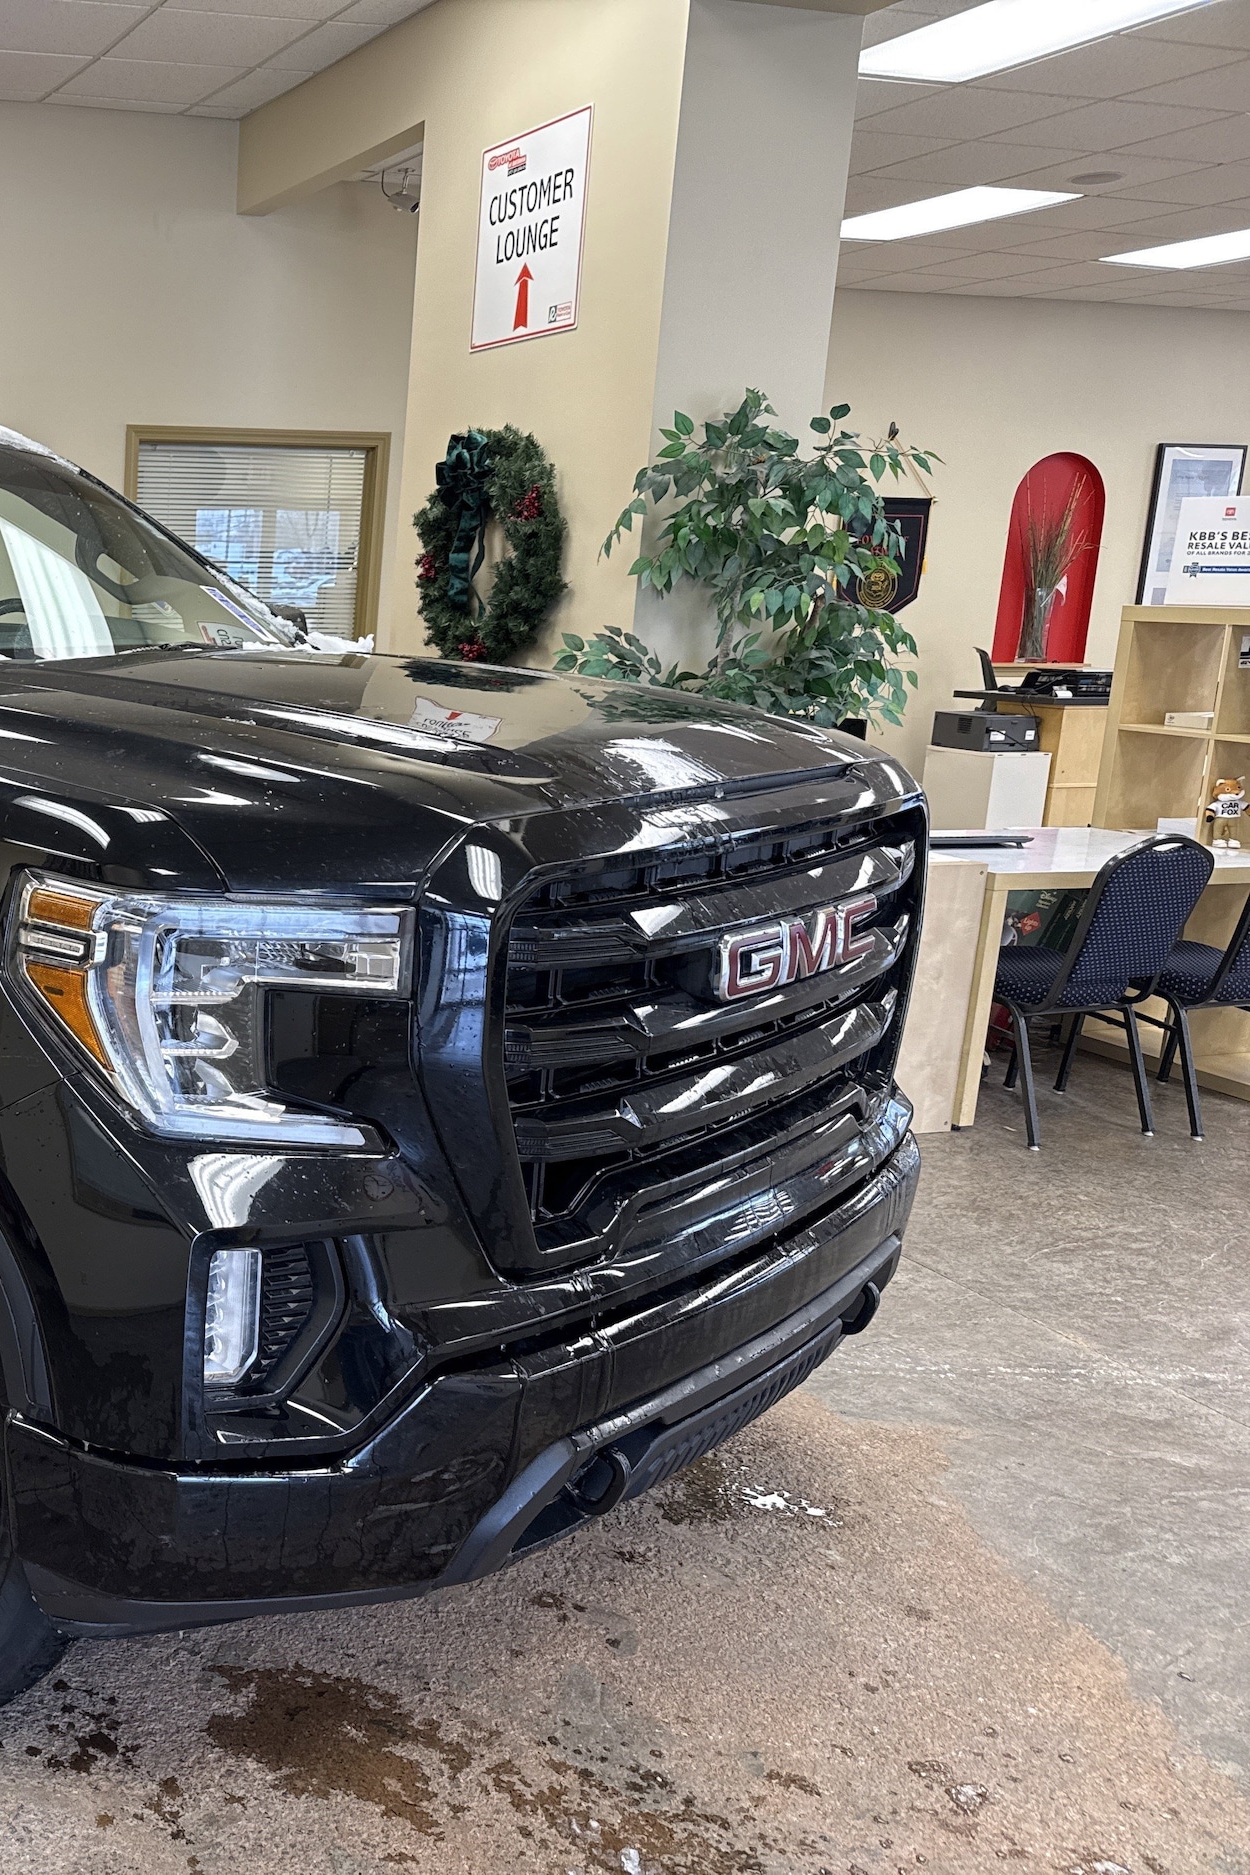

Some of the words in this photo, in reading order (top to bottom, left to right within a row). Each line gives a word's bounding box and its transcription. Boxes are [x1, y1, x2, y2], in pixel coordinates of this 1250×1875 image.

[489, 167, 575, 226] CUSTOMER
[496, 215, 560, 265] LOUNGE
[1187, 542, 1226, 550] RESALE
[1228, 542, 1250, 550] VAL
[1189, 531, 1229, 541] KBB'S
[1231, 531, 1250, 541] BE
[719, 893, 878, 1000] GMC
